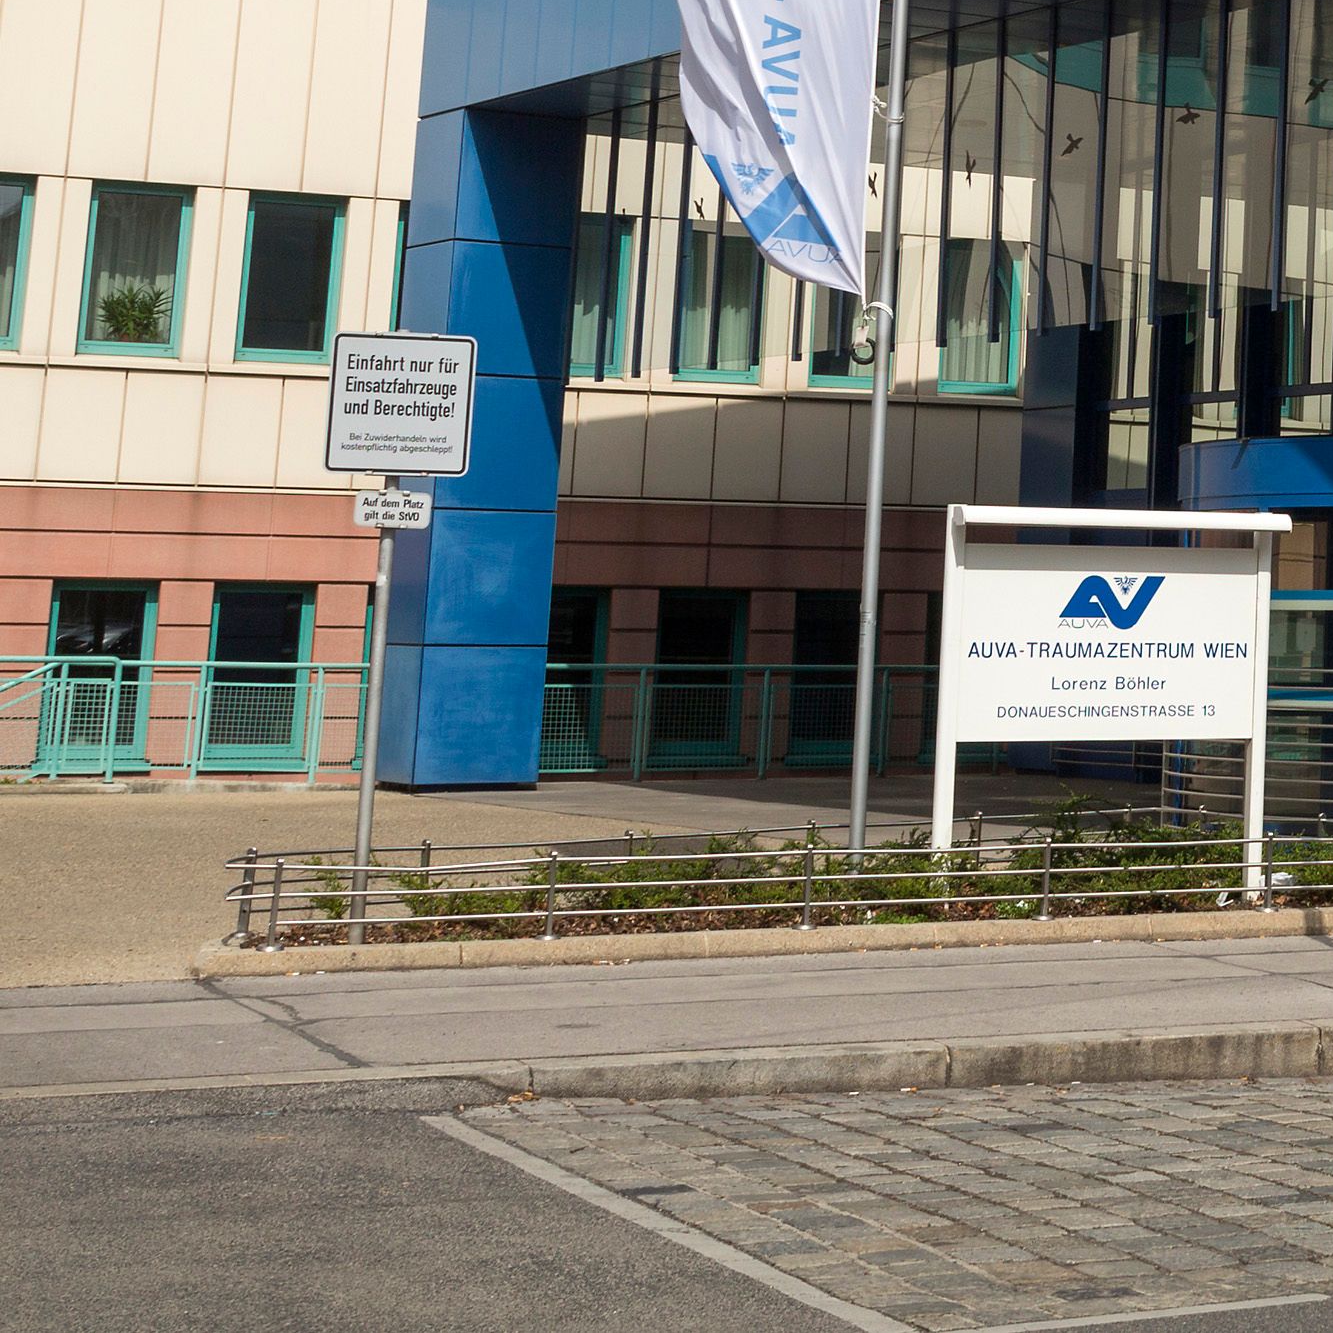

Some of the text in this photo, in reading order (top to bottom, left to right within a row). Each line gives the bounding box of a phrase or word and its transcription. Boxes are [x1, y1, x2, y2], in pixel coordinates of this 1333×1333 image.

[347, 353, 460, 374] Einfahrt nur für
[345, 376, 457, 400] Einsatzfahrzeuge
[343, 399, 455, 422] und Berechtigte!
[349, 432, 362, 441] Bei
[364, 433, 427, 443] Zuwiderhandeln
[340, 442, 454, 455] kostenpflichtig abgeschleppt!
[362, 496, 425, 509] Auf dem Platz
[363, 509, 420, 521] gilt die StVO
[1057, 618, 1109, 629] AUVA
[967, 641, 1248, 659] AUVA-TRAUMAZENTRUM WIEN
[1051, 676, 1167, 691] Lorenz Böhler
[997, 705, 1216, 719] DONAUESCHINGENSTRASSE 13
